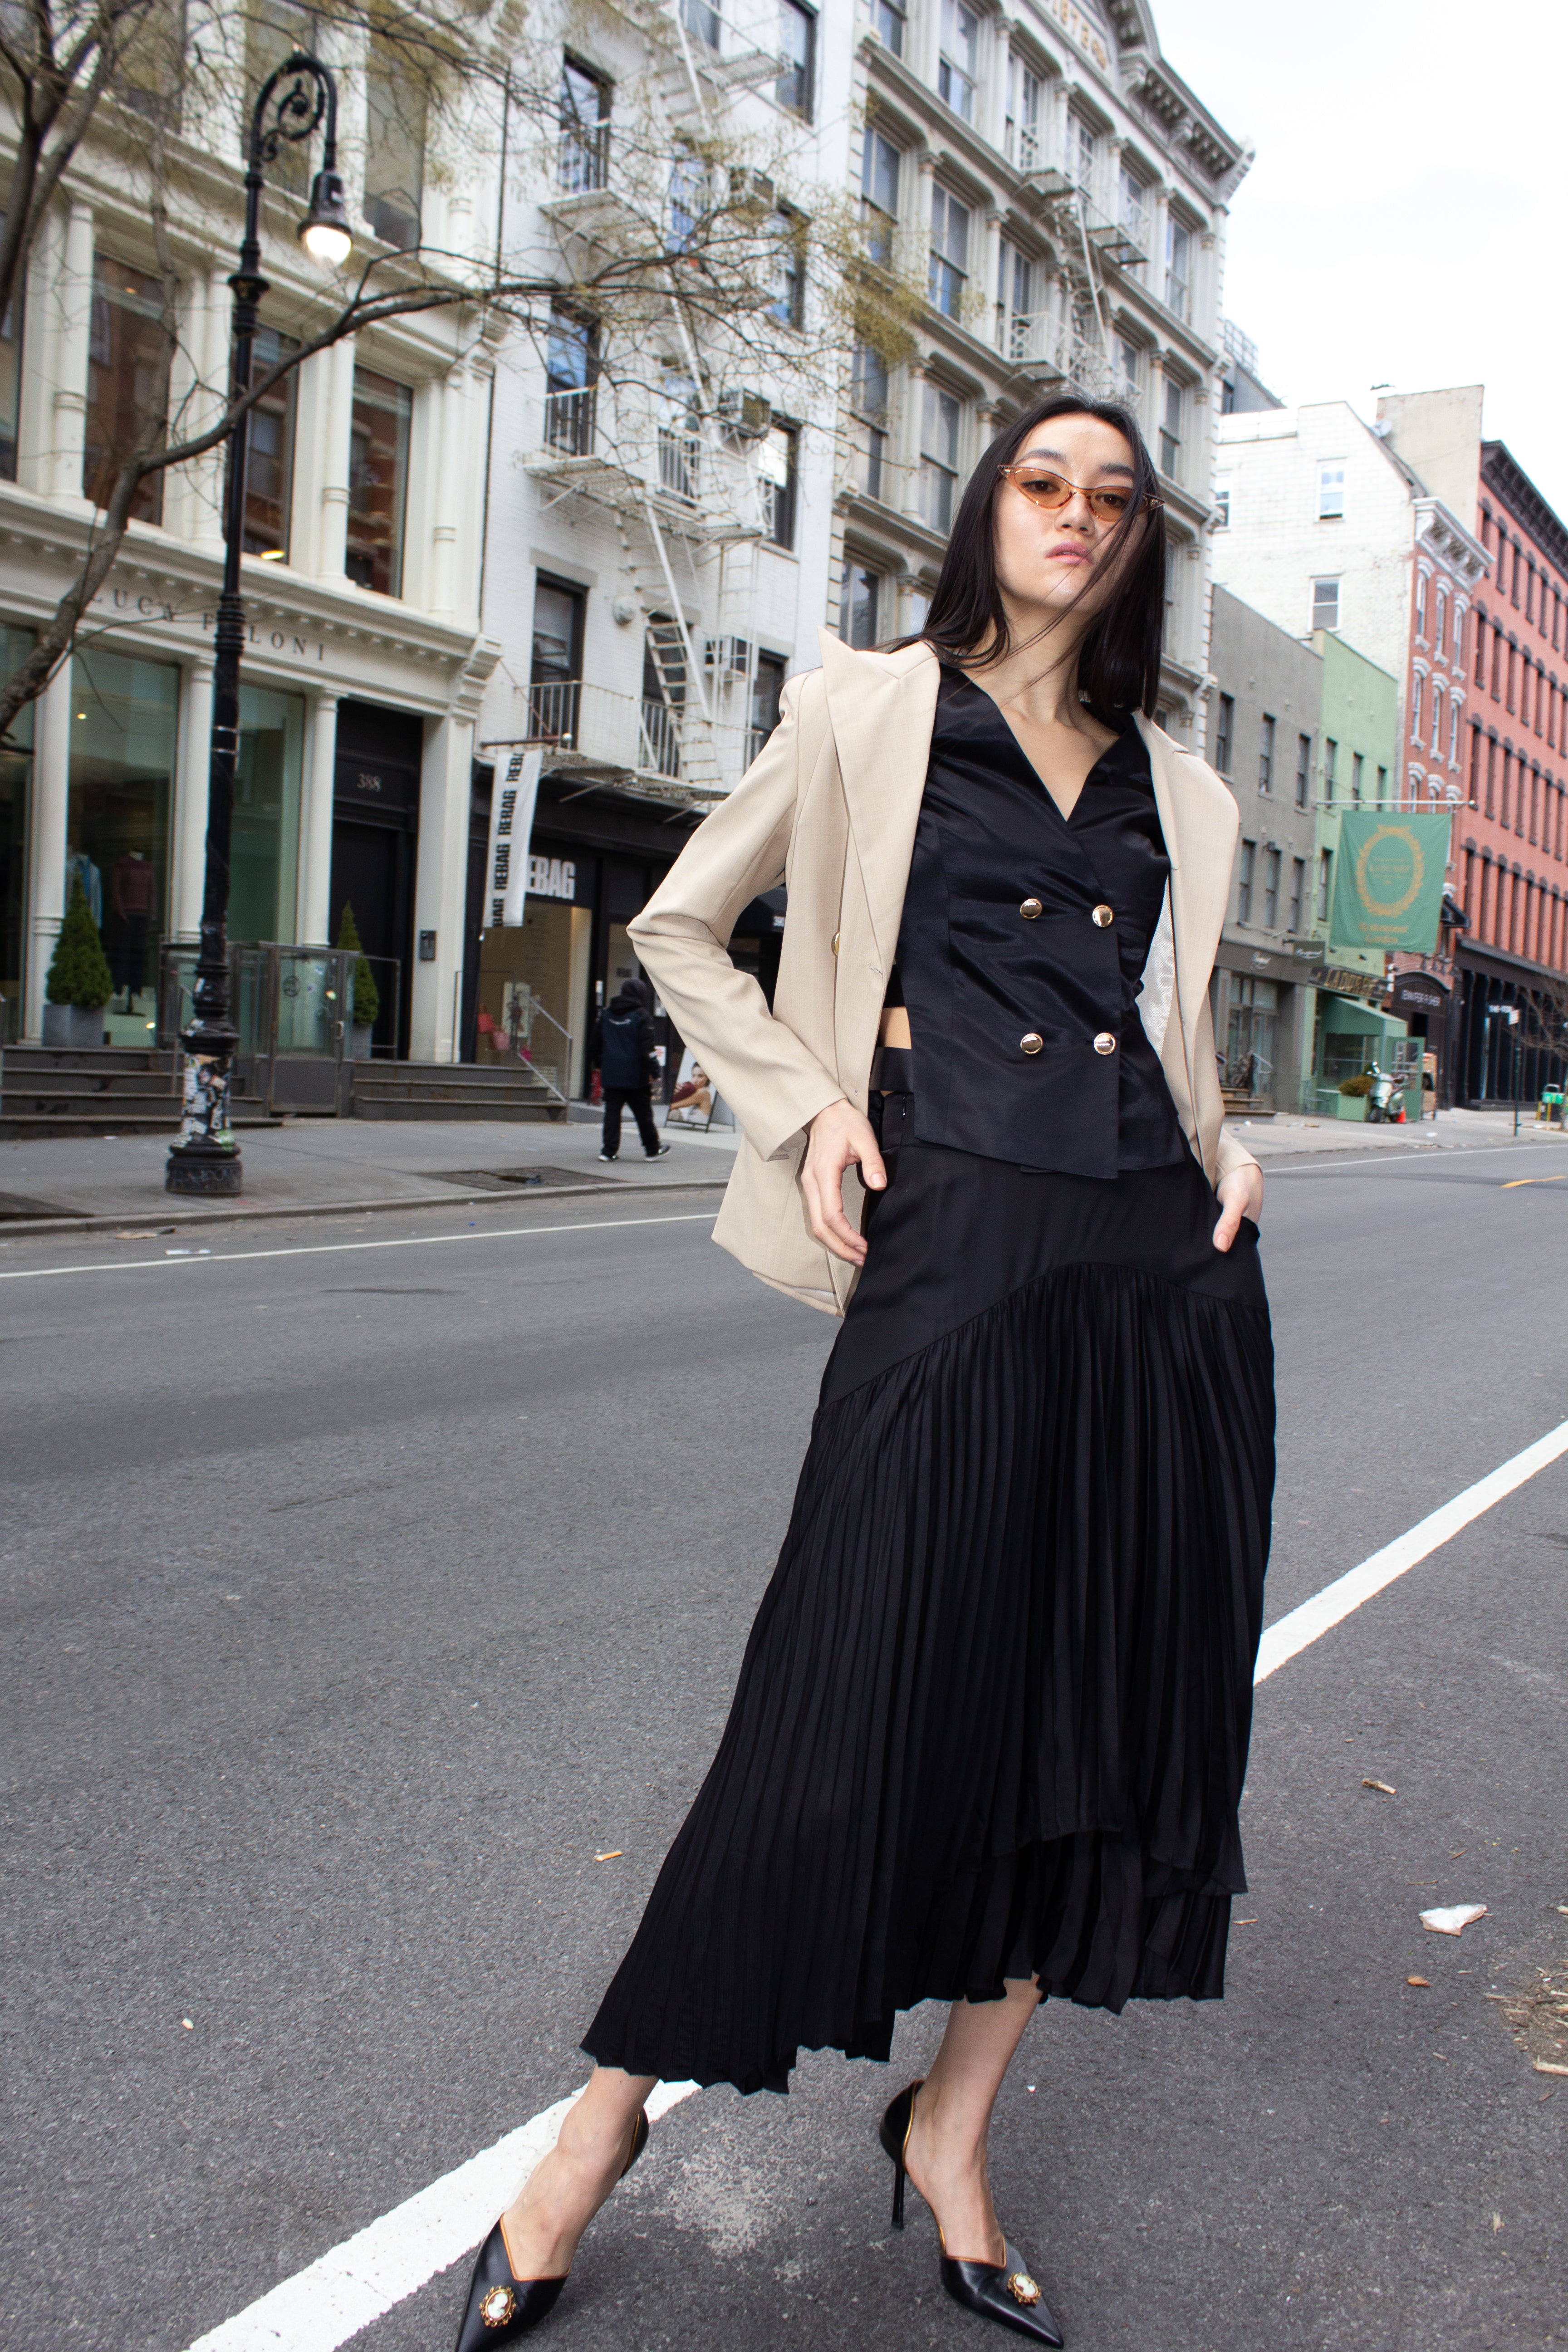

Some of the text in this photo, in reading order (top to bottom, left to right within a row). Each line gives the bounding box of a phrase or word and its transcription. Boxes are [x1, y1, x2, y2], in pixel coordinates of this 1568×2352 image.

[93, 588, 323, 660] UCA FLONI
[525, 854, 576, 900] EBAG
